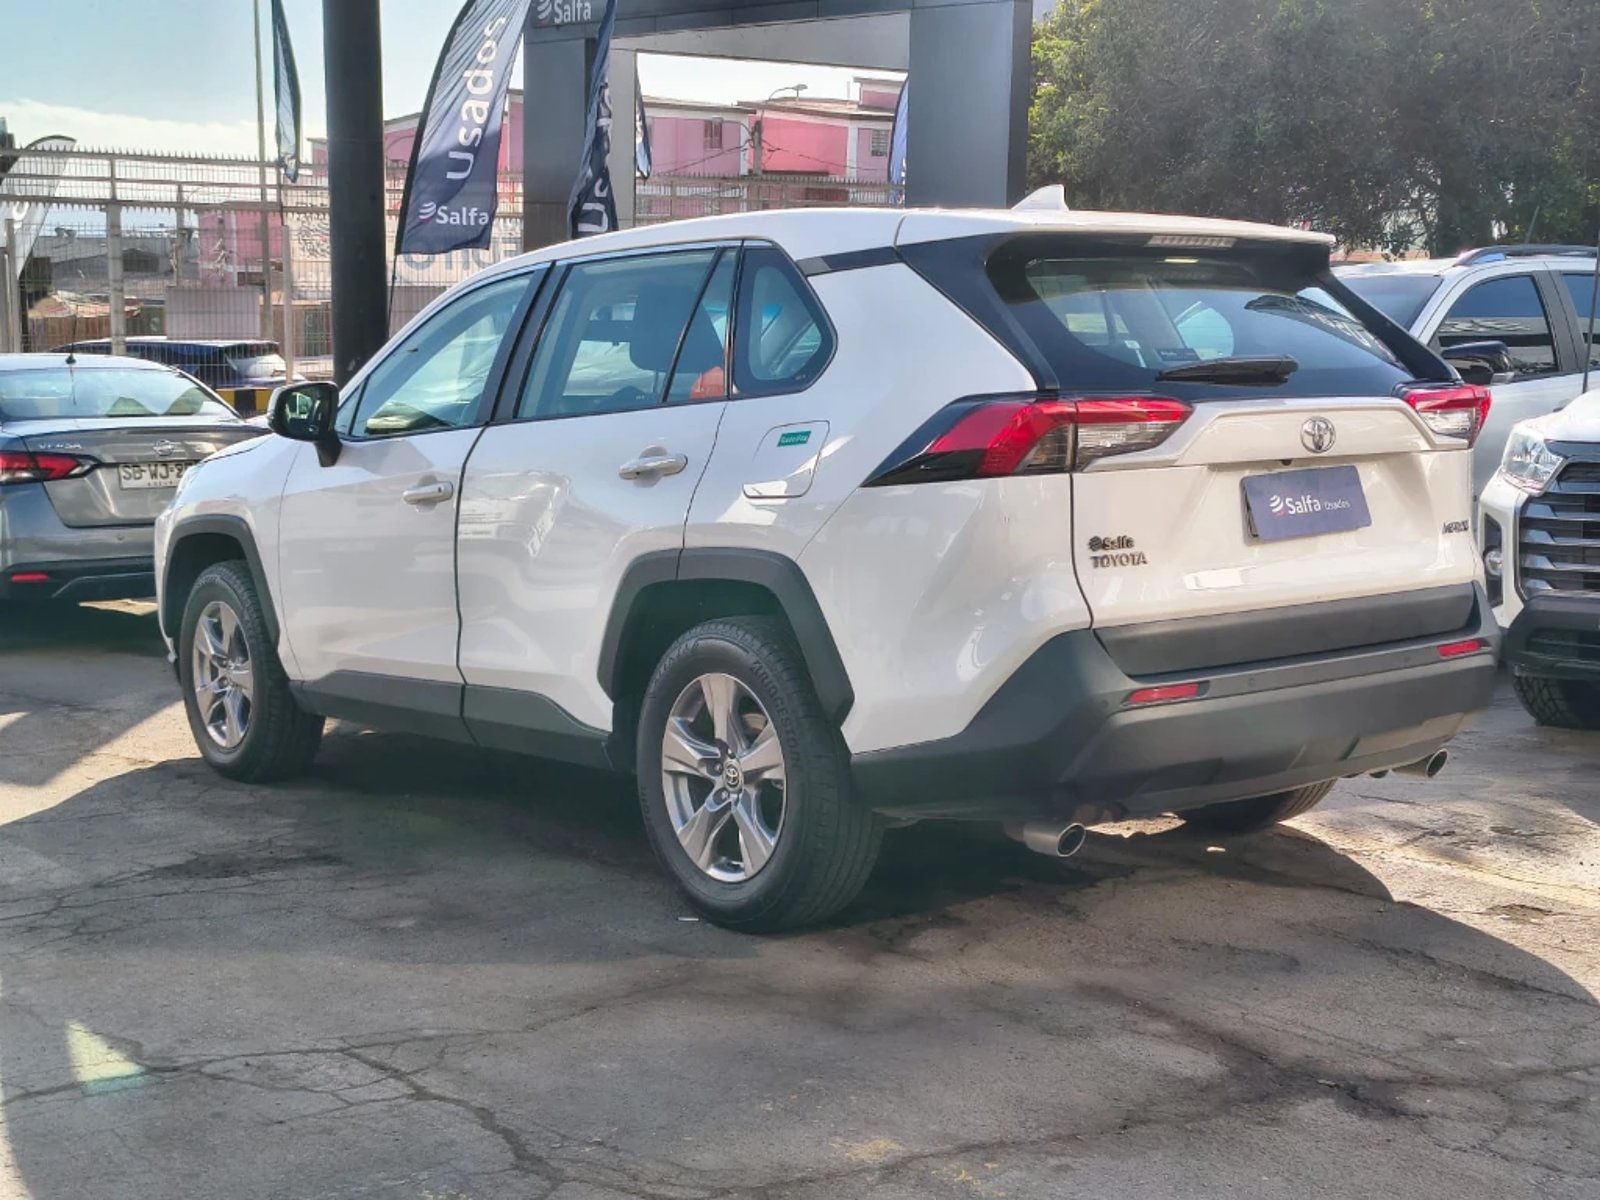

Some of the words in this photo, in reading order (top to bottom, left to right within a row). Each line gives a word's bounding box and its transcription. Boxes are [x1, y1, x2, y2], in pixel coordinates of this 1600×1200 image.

[553, 0, 592, 24] Salfa
[446, 16, 506, 180] Usados
[436, 205, 489, 225] Salfa
[1285, 494, 1322, 514] Salfa
[1090, 551, 1148, 568] TOYOTA
